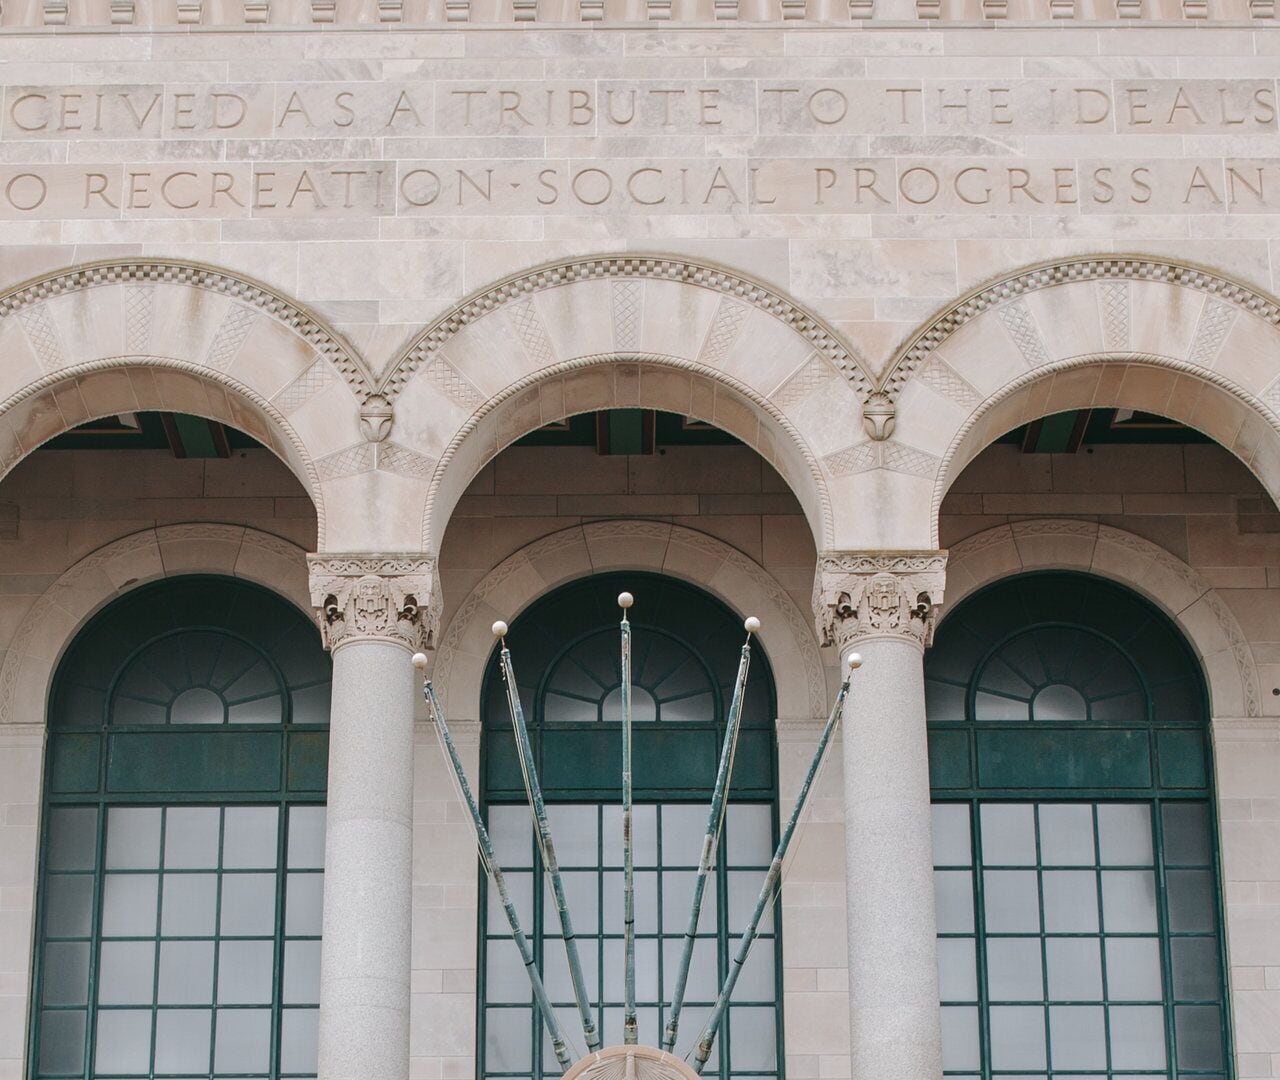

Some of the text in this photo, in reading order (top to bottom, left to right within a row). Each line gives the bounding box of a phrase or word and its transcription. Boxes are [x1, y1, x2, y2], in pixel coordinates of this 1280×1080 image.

[277, 90, 357, 130] AS
[385, 90, 426, 128] A
[450, 89, 723, 128] TRIBUTE
[761, 87, 850, 127] TO
[885, 87, 1015, 126] THE
[1049, 86, 1276, 126] IDEALS
[83, 169, 494, 211] RECREATION
[536, 167, 777, 207] SOCIAL
[814, 166, 1153, 206] PROGRESS
